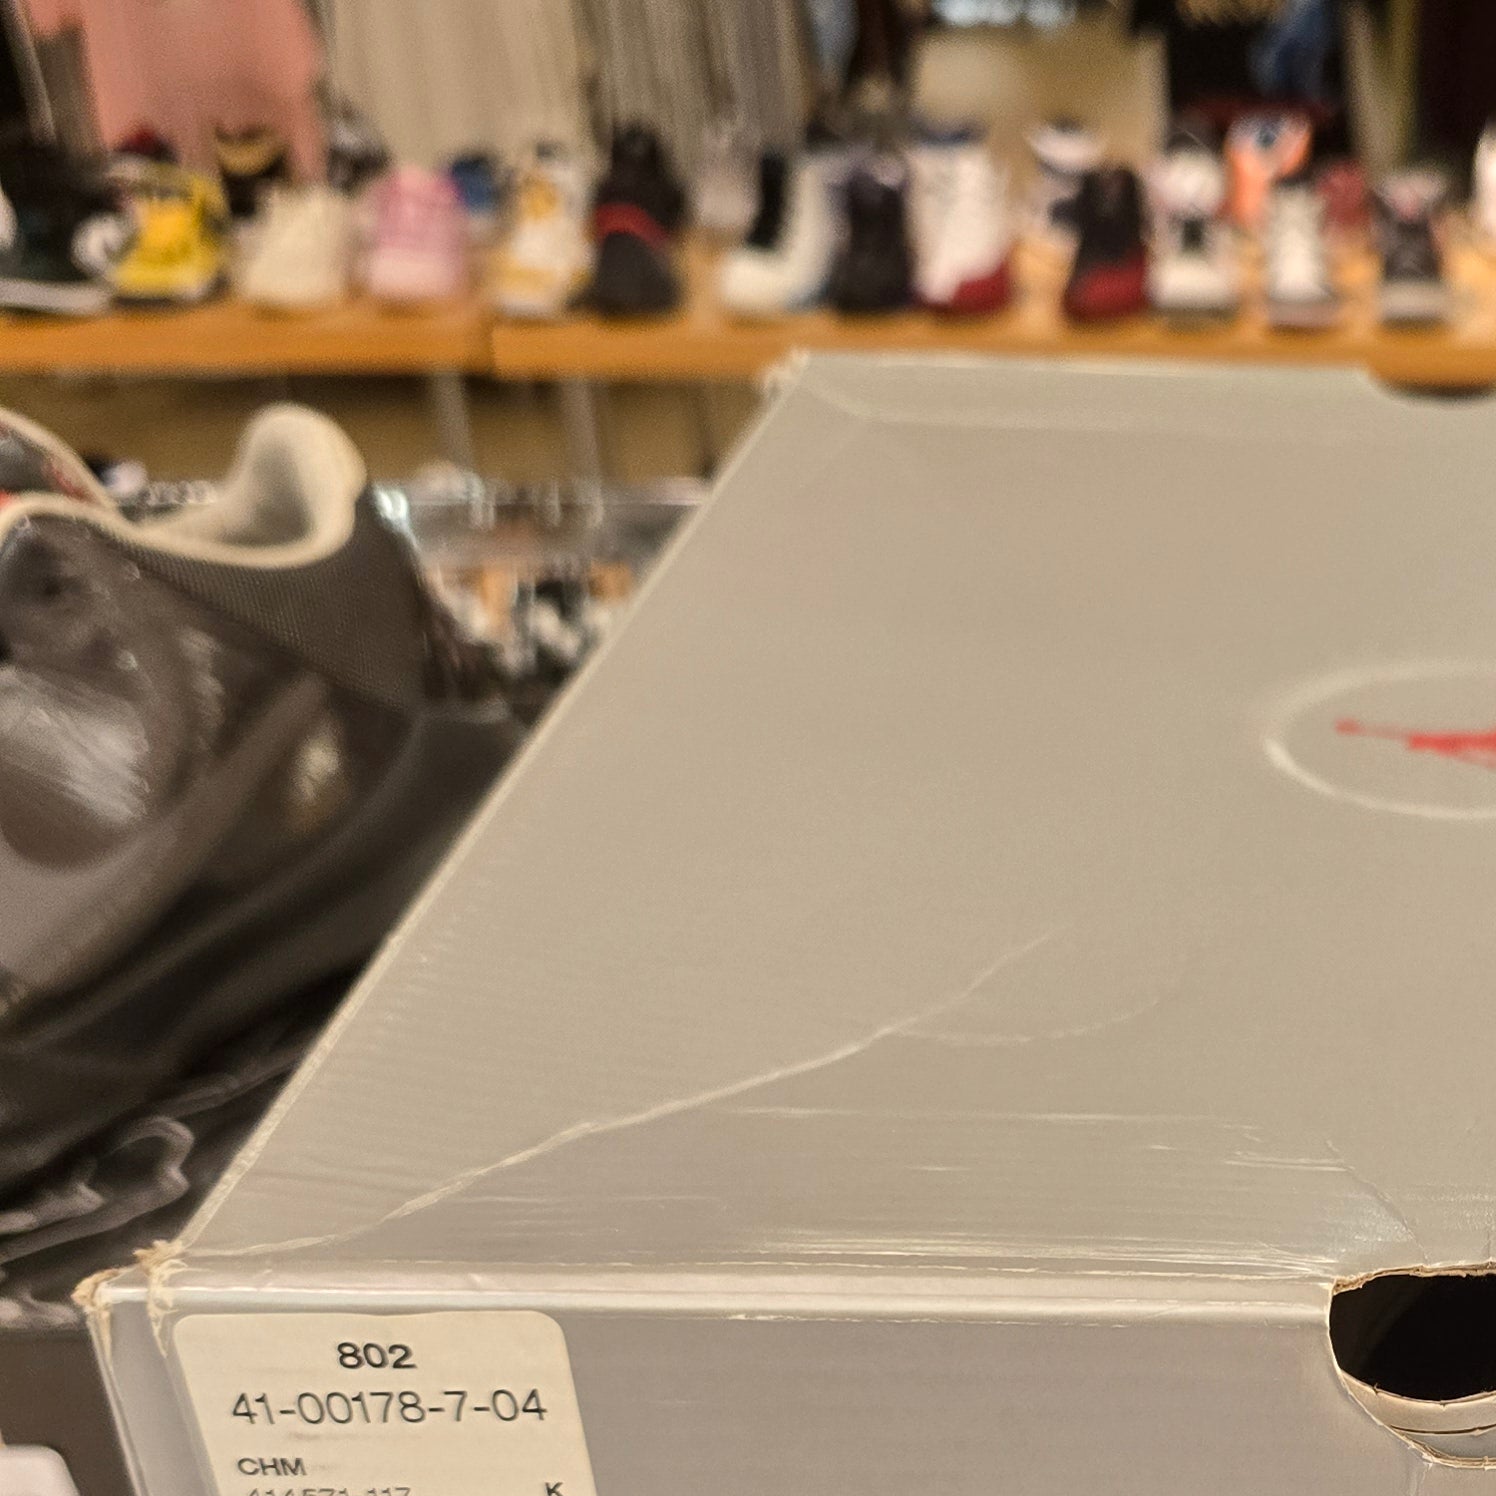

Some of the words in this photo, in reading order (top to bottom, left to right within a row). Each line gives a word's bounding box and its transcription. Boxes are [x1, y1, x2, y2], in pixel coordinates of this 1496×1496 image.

[337, 1342, 417, 1369] 802
[232, 1389, 548, 1425] 41-00178-7-04
[237, 1457, 307, 1476] CHM
